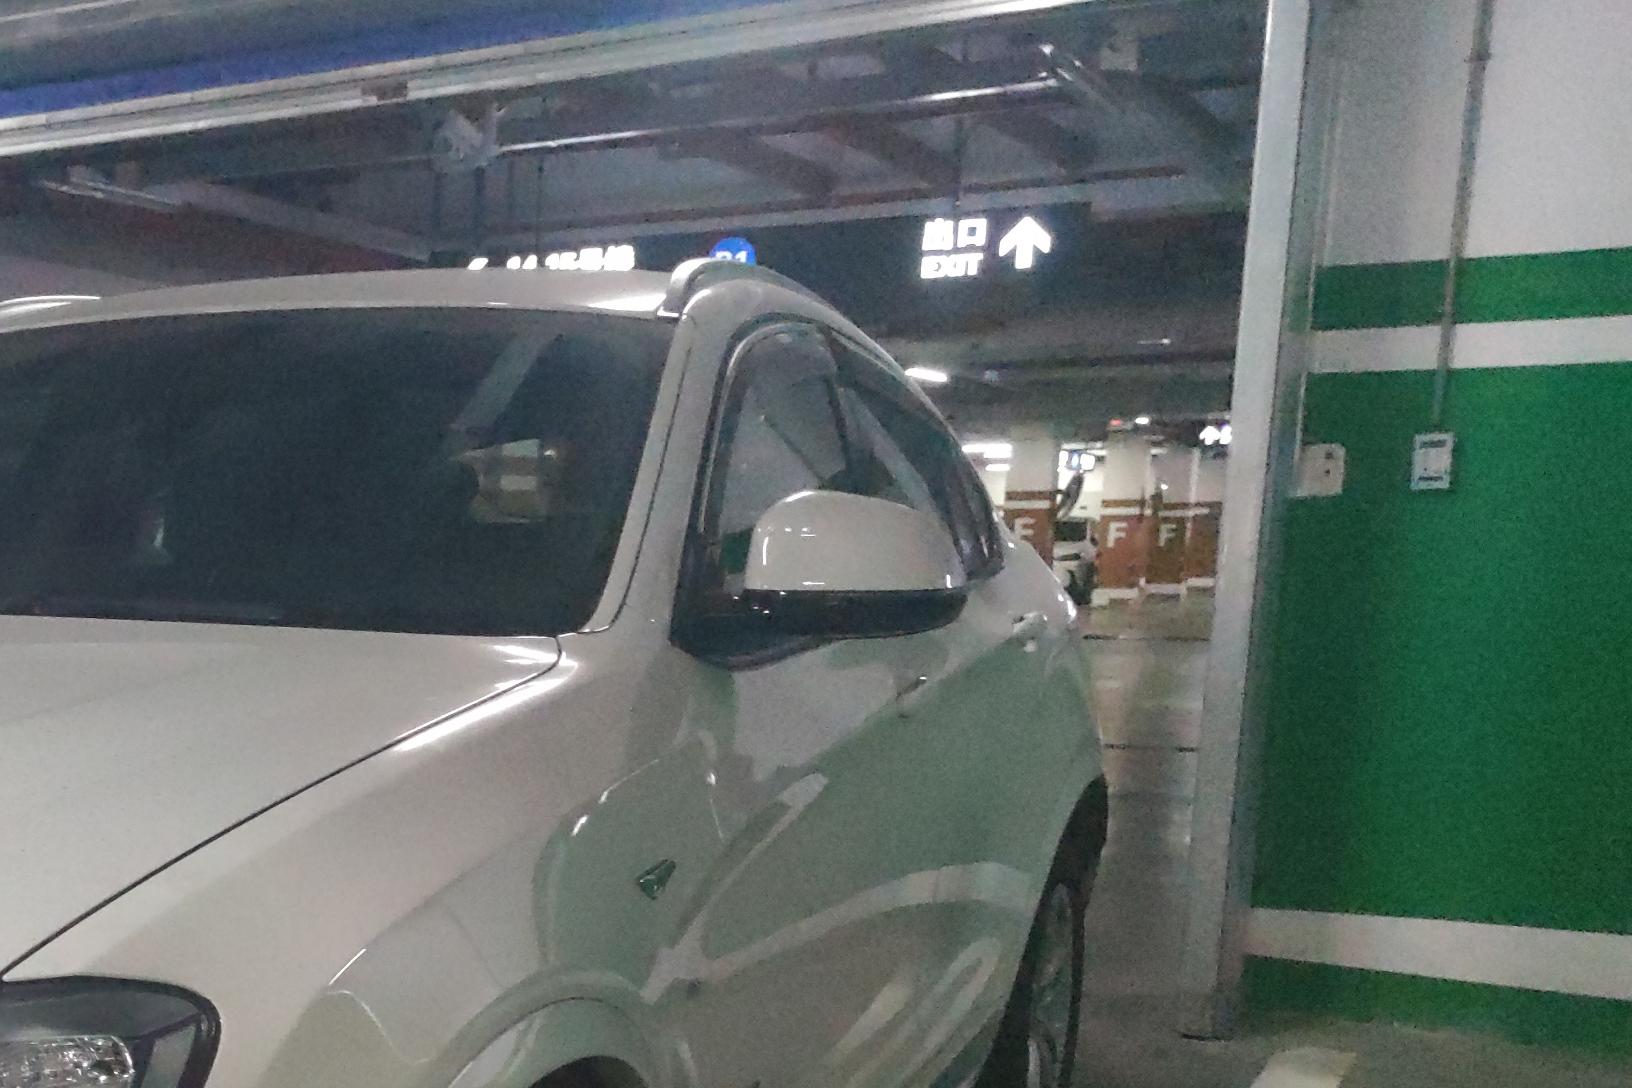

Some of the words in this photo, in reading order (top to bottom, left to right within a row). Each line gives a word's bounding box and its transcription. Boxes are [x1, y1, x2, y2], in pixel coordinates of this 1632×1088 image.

[922, 218, 987, 251] 出口
[920, 253, 984, 279] EXIT
[1106, 521, 1128, 548] F
[1158, 523, 1176, 547] F
